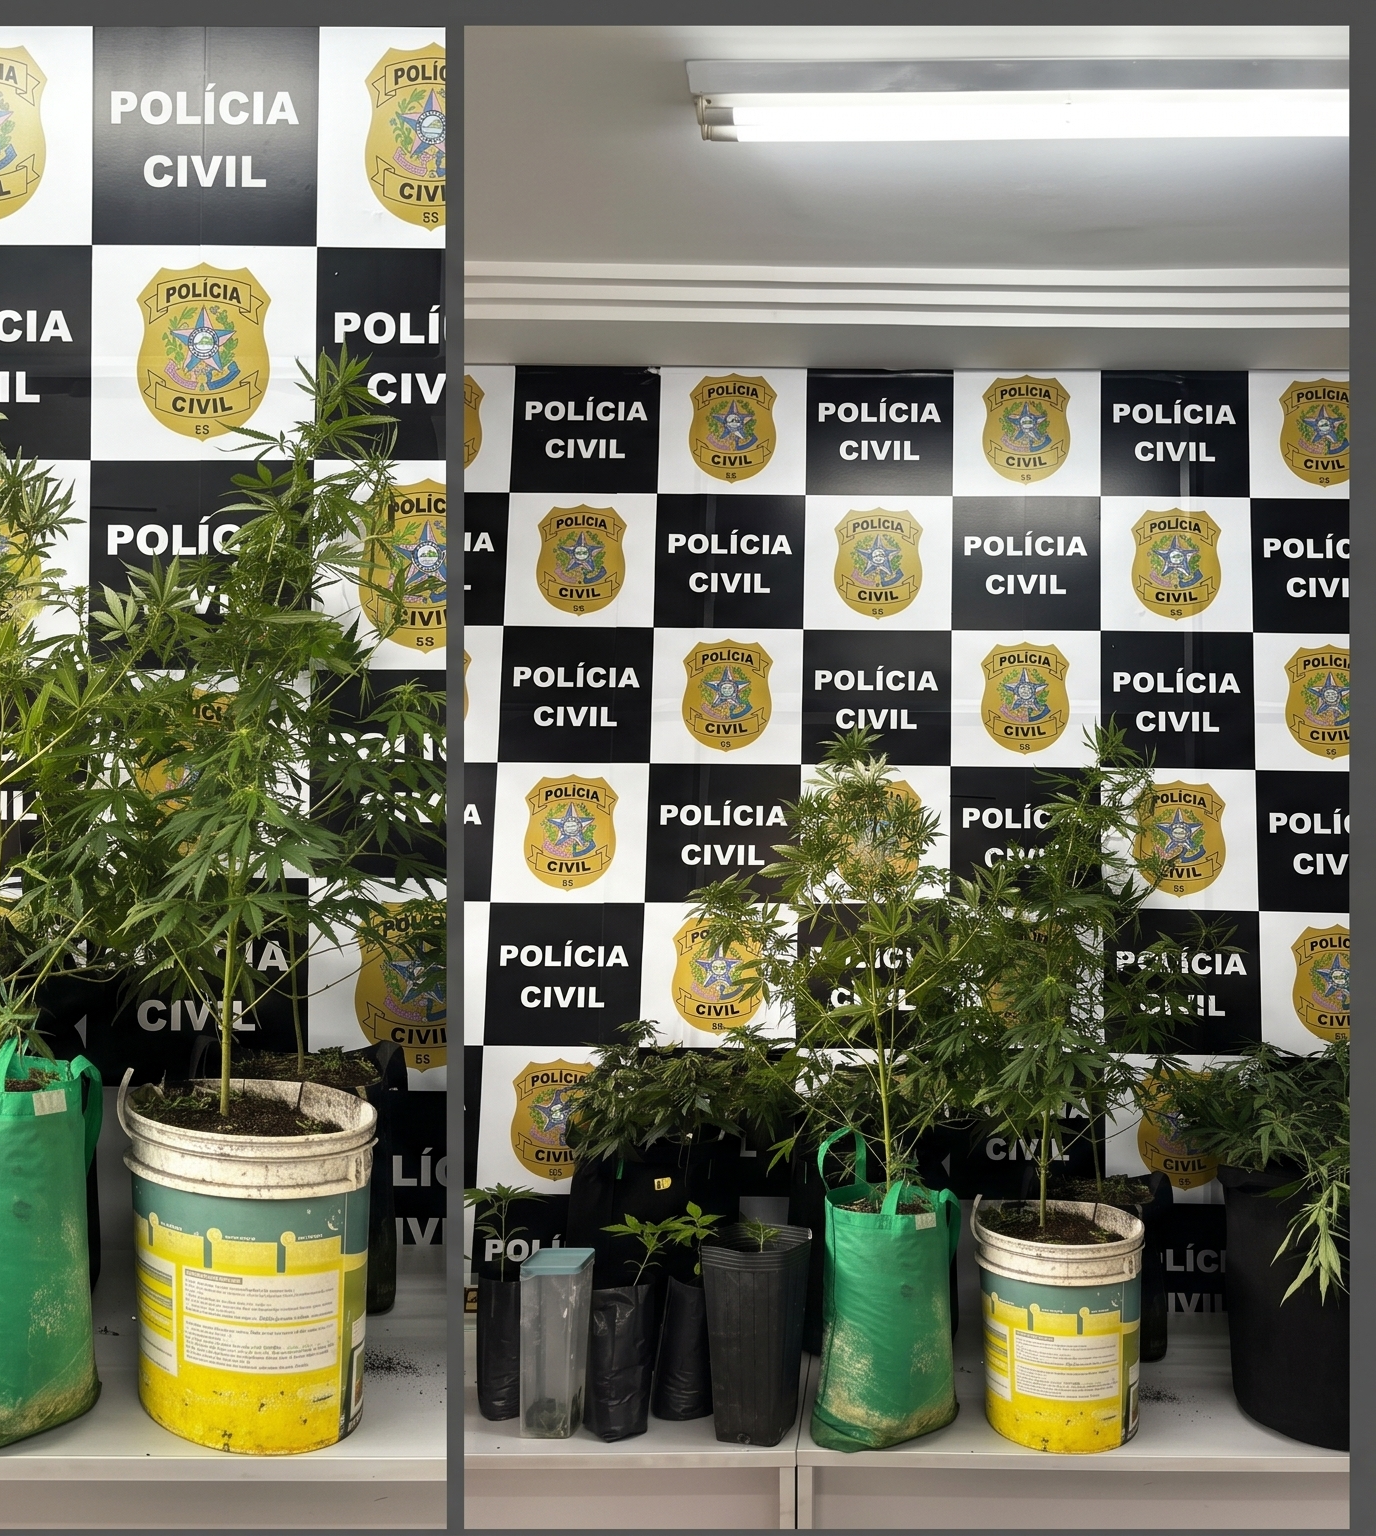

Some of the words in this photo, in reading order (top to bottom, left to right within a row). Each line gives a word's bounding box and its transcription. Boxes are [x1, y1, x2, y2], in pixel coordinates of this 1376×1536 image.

[110, 83, 299, 126] POLÍCIA
[143, 155, 267, 188] CIVIL
[165, 278, 242, 304] POLÍCIA
[333, 305, 446, 344] POLÍ
[707, 383, 759, 399] POLÍCIA
[1000, 385, 1051, 400] POLÍCIA
[171, 396, 233, 414] CIVIL
[525, 397, 648, 421] POLÍCIA
[818, 398, 941, 423] POLÍCIA
[1112, 400, 1236, 425] POLÍCIA
[545, 439, 625, 459] CIVIL
[839, 440, 920, 461] CIVIL
[1134, 441, 1216, 462] CIVIL
[711, 454, 752, 466] CIVIL
[1006, 456, 1047, 467] CIVIL
[1304, 459, 1345, 470] CIVIL
[556, 515, 607, 530] POLÍCIA
[852, 518, 904, 533] POLÍCIA
[1149, 518, 1201, 533] POLÍCIA
[668, 529, 792, 555] POLÍCIA
[964, 531, 1088, 556] POLÍCIA
[559, 587, 601, 599] CIVIL
[689, 572, 771, 594] CIVIL
[985, 574, 1066, 595] CIVIL
[858, 590, 899, 602] CIVIL
[1155, 591, 1198, 603] CIVIL
[702, 650, 753, 666] POLÍCIA
[999, 652, 1051, 667] POLÍCIA
[513, 662, 640, 688] POLÍCIA
[814, 665, 938, 692] POLÍCIA
[1113, 668, 1241, 694] POLÍCIA
[533, 706, 618, 727] CIVIL
[835, 708, 917, 730] CIVIL
[1135, 711, 1220, 733] CIVIL
[705, 723, 748, 735] CIVIL
[1004, 725, 1046, 737] CIVIL
[545, 785, 600, 802] POLÍCIA
[660, 800, 788, 827] POLÍCIA
[1269, 808, 1349, 834] POLÍ
[681, 844, 765, 866] CIVIL
[547, 861, 591, 873] CIVIL
[499, 940, 629, 968] POLÍCIA
[520, 986, 605, 1009] CIVIL
[696, 1004, 740, 1017] CIVIL
